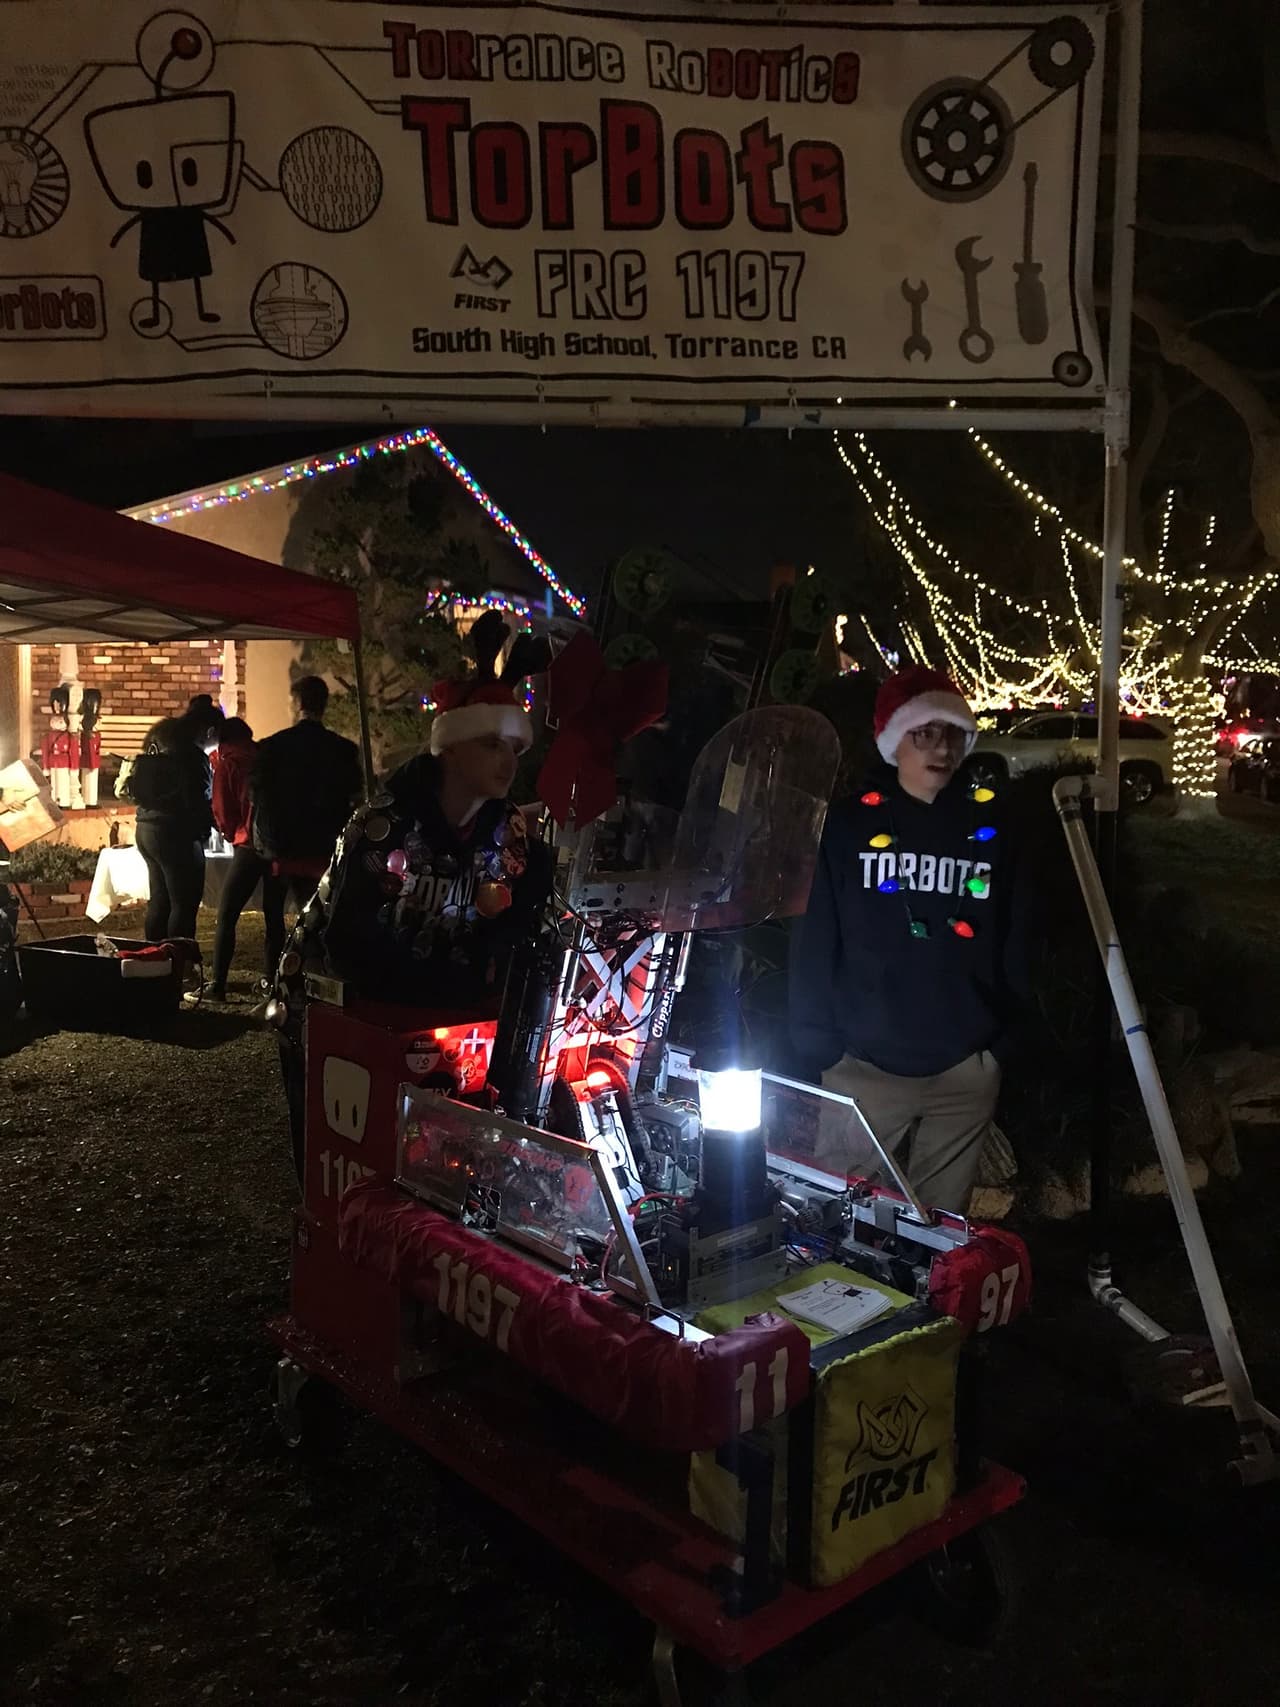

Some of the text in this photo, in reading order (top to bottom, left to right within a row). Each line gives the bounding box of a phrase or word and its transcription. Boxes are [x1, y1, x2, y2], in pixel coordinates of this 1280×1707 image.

[401, 95, 848, 236] TorBots
[0, 285, 97, 329] rBots
[454, 293, 511, 313] FIRST
[534, 248, 805, 322] FRC 1197
[412, 327, 846, 360] South High School, Torrance CA
[433, 1252, 521, 1354] 1197
[976, 1262, 1021, 1334] 97
[735, 1346, 789, 1435] 11
[831, 1449, 938, 1533] FIRST
